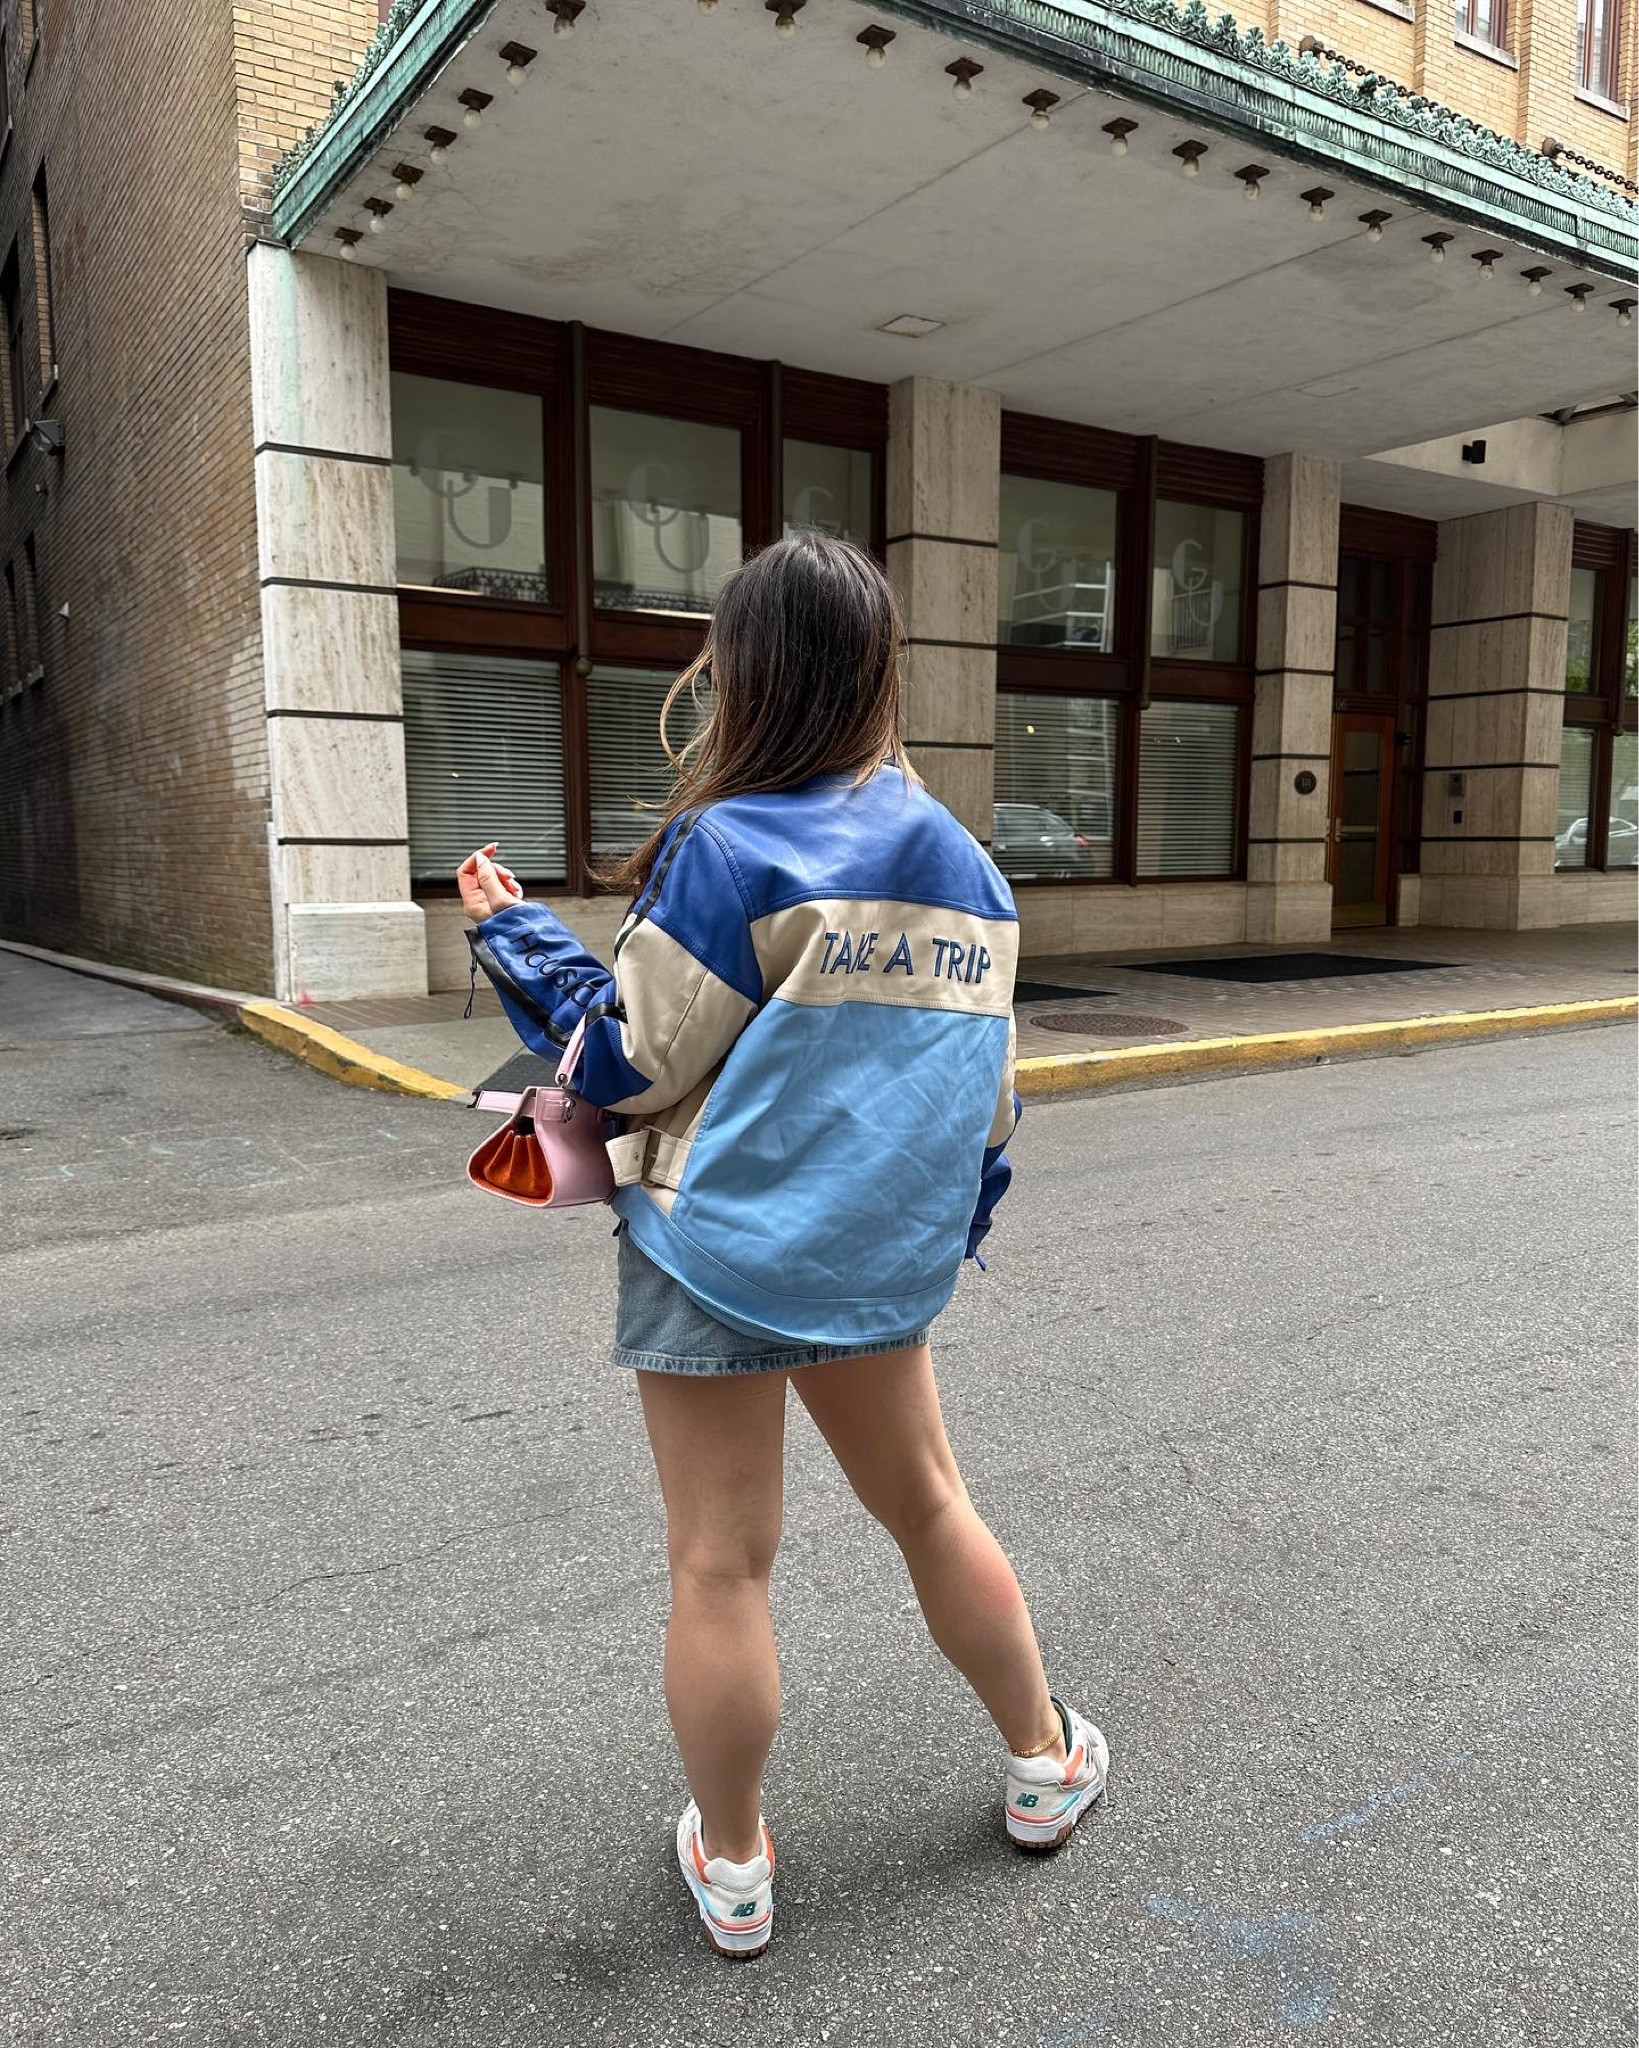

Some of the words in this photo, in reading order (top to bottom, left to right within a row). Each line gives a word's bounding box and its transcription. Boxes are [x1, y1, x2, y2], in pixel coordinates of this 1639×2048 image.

[819, 930, 879, 975] TAKE
[882, 932, 914, 976] A
[932, 937, 992, 984] TRIP
